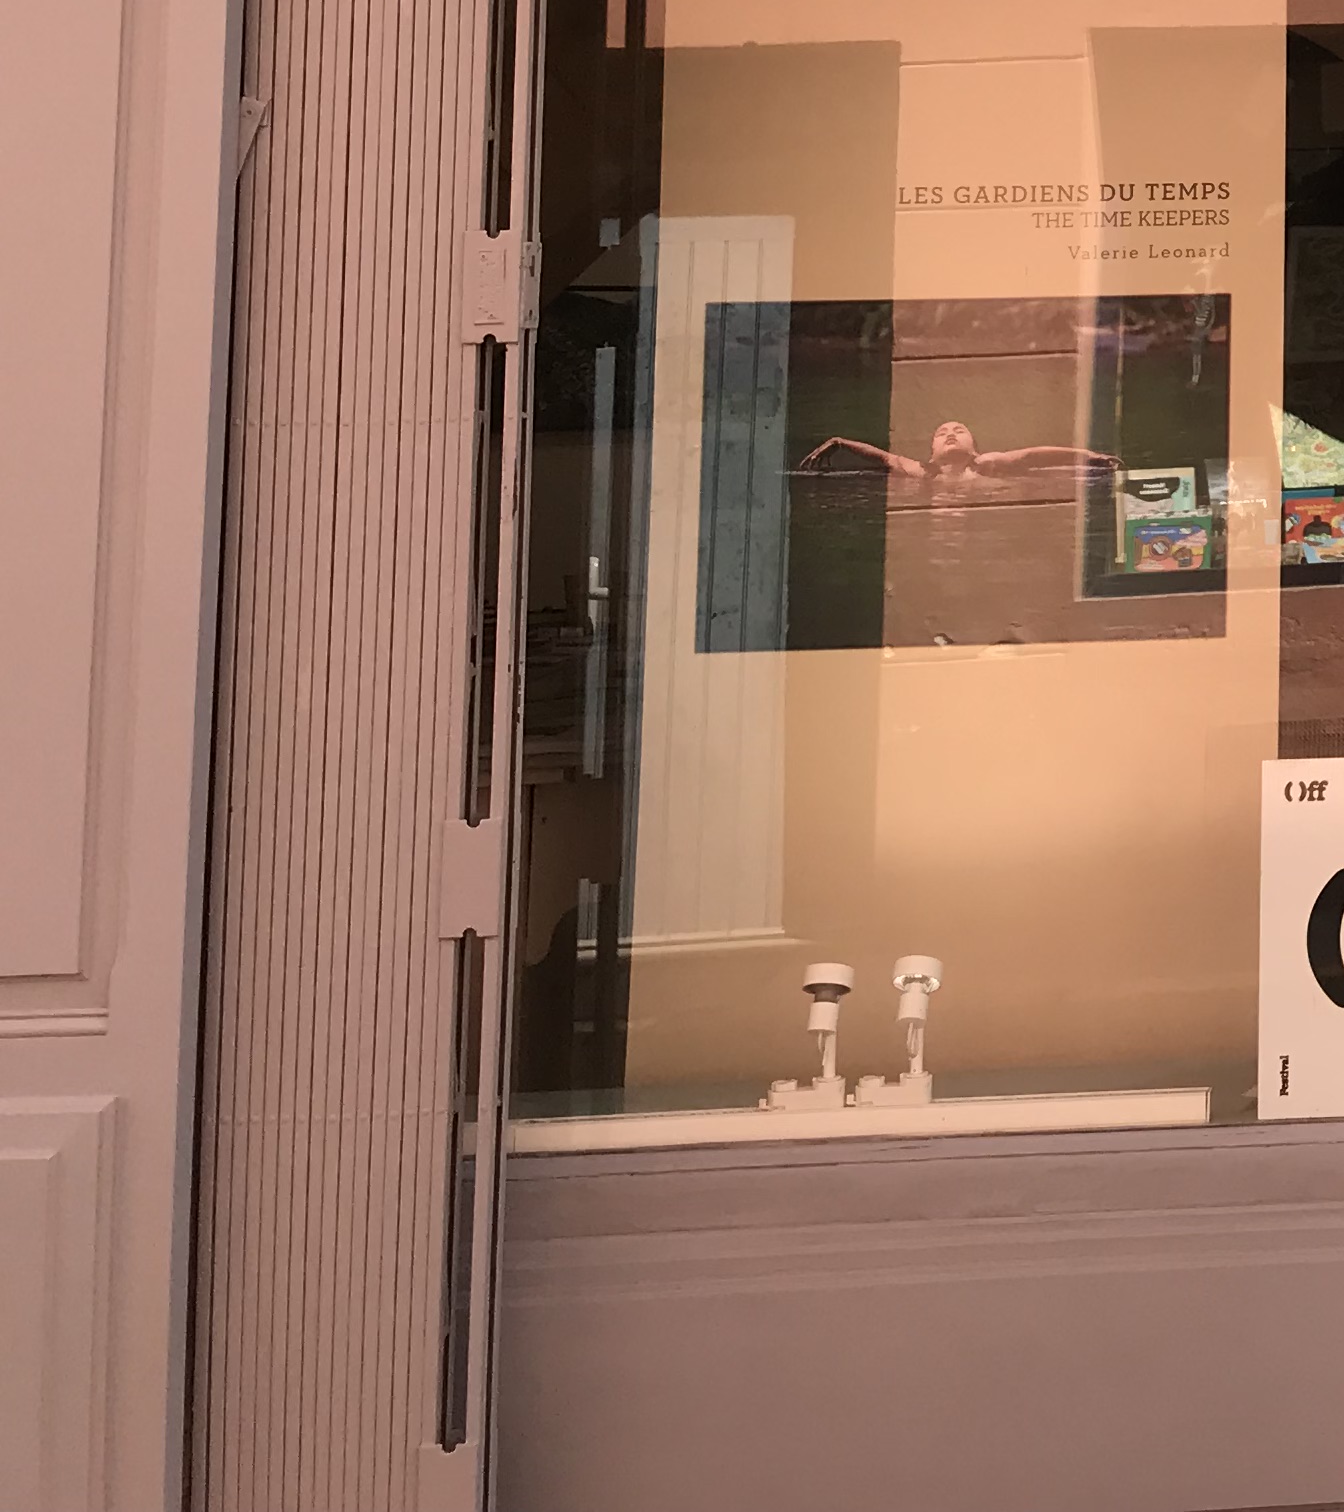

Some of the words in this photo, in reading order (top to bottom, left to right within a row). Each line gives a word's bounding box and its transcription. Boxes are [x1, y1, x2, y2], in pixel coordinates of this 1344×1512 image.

[898, 186, 943, 205] LES
[953, 184, 1090, 205] GARDIENS
[1099, 183, 1136, 202] DU
[1145, 181, 1231, 201] TEMPS
[1032, 211, 1074, 229] THE
[1080, 210, 1132, 228] TIME
[1137, 209, 1230, 227] KEEPERS
[1068, 245, 1139, 261] Valerie
[1148, 242, 1231, 259] Leonard
[1279, 1055, 1289, 1097] Festival
